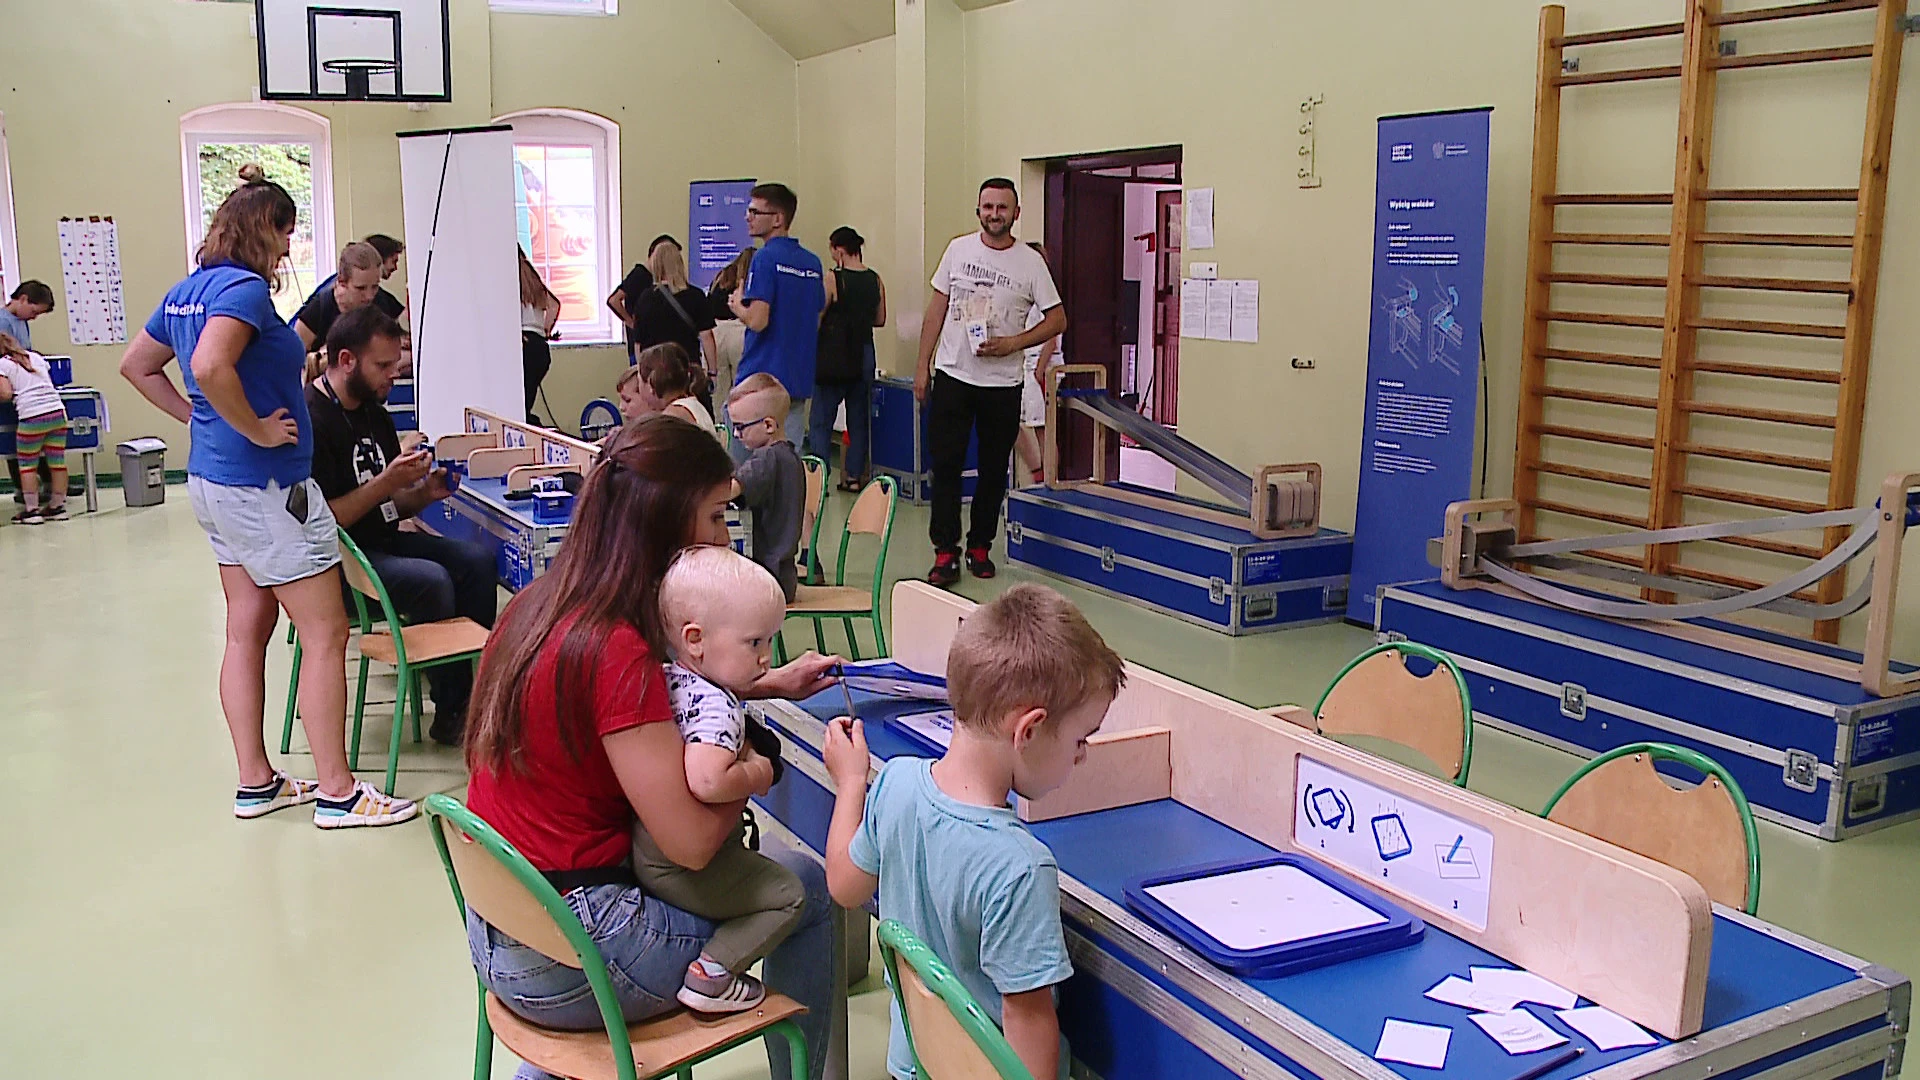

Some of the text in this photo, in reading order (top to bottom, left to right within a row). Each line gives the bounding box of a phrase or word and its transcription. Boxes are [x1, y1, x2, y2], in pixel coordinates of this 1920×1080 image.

[1320, 839, 1325, 848] 1
[1383, 868, 1388, 877] 2
[1453, 900, 1458, 909] 3
